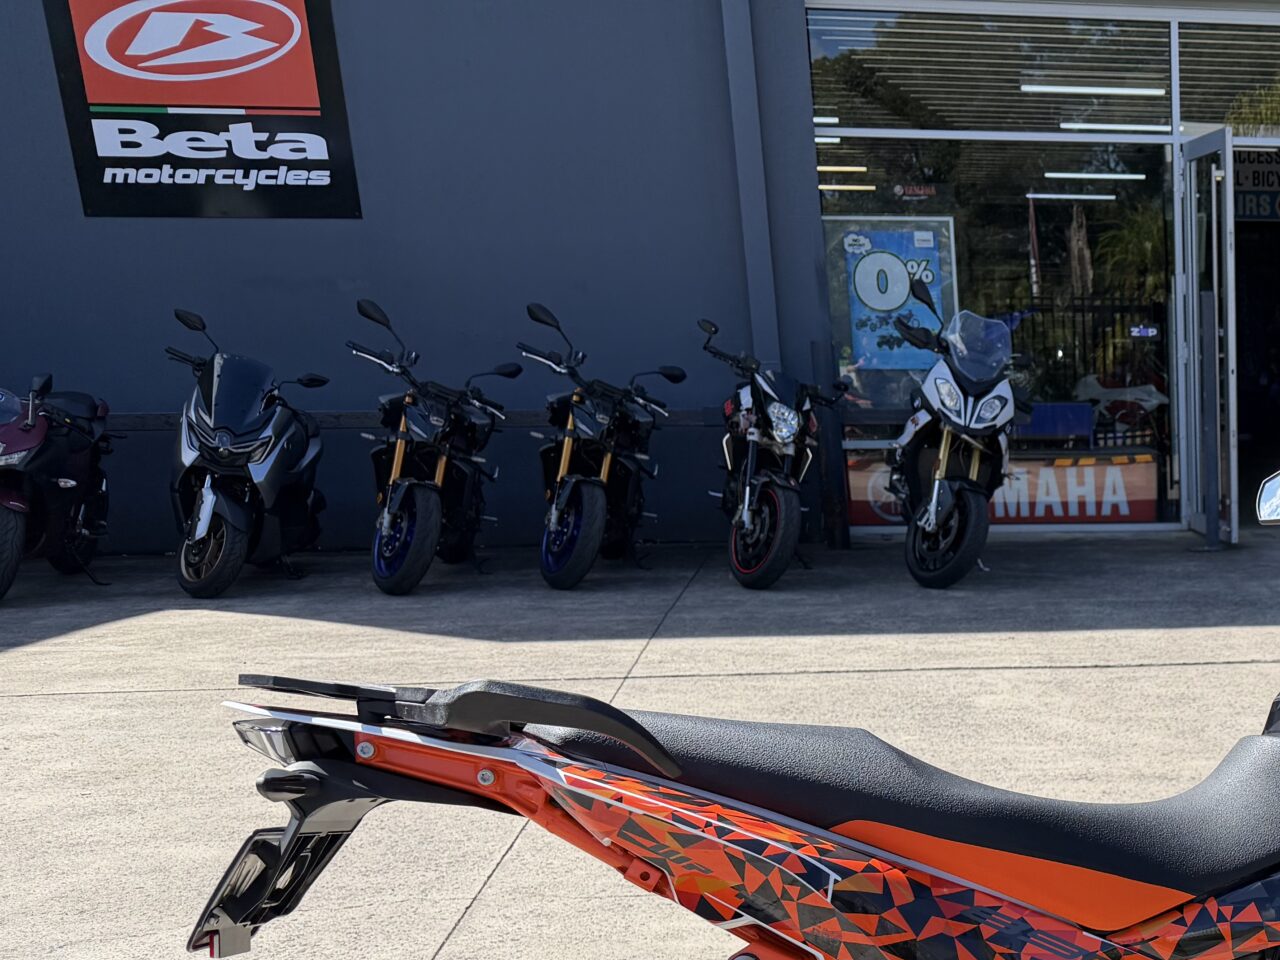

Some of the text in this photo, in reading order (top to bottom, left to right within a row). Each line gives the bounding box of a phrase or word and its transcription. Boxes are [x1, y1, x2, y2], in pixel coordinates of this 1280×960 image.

[90, 118, 330, 161] Beta
[102, 164, 332, 191] motorcycles
[994, 466, 1131, 518] MAHA
